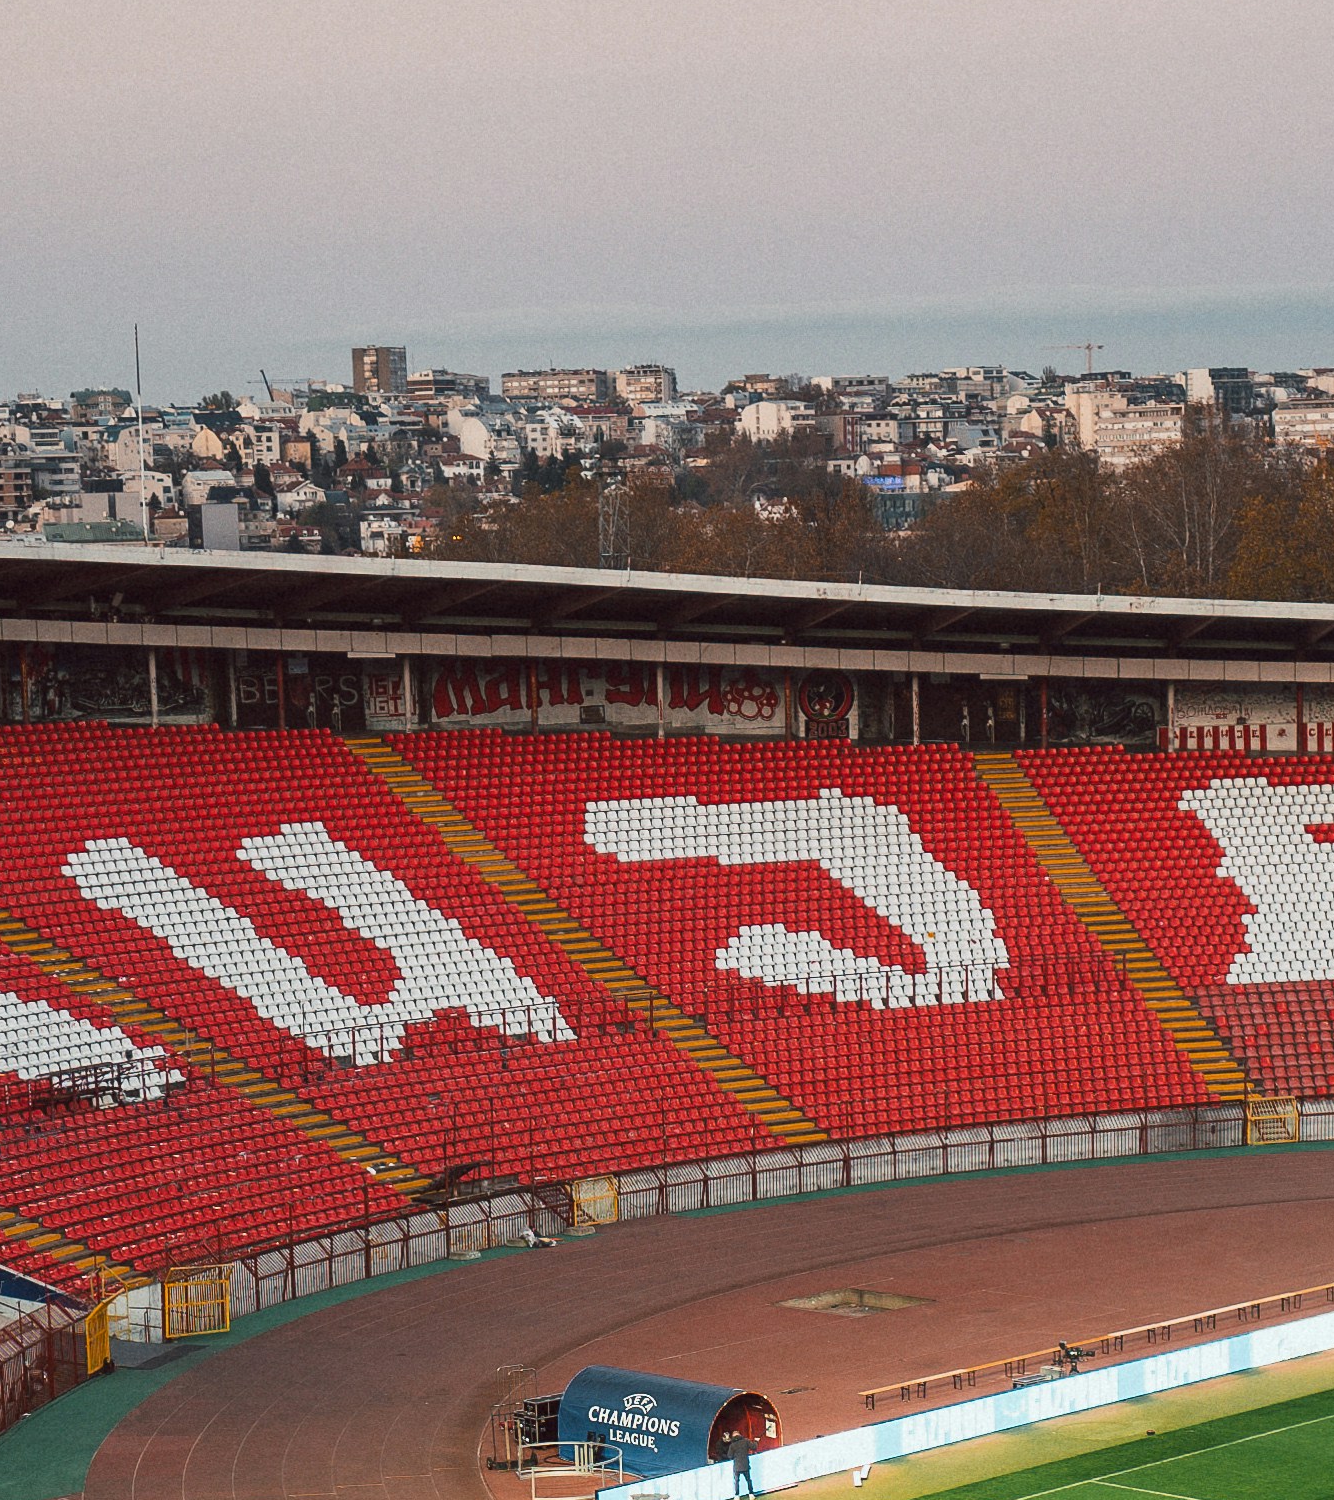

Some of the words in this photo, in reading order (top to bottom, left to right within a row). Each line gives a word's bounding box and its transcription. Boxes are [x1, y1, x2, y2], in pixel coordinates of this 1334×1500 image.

[808, 720, 848, 738] 2003
[623, 1394, 655, 1414] UEFA
[588, 1405, 681, 1437] CHAMPIONS
[609, 1428, 656, 1449] LEAGUE
